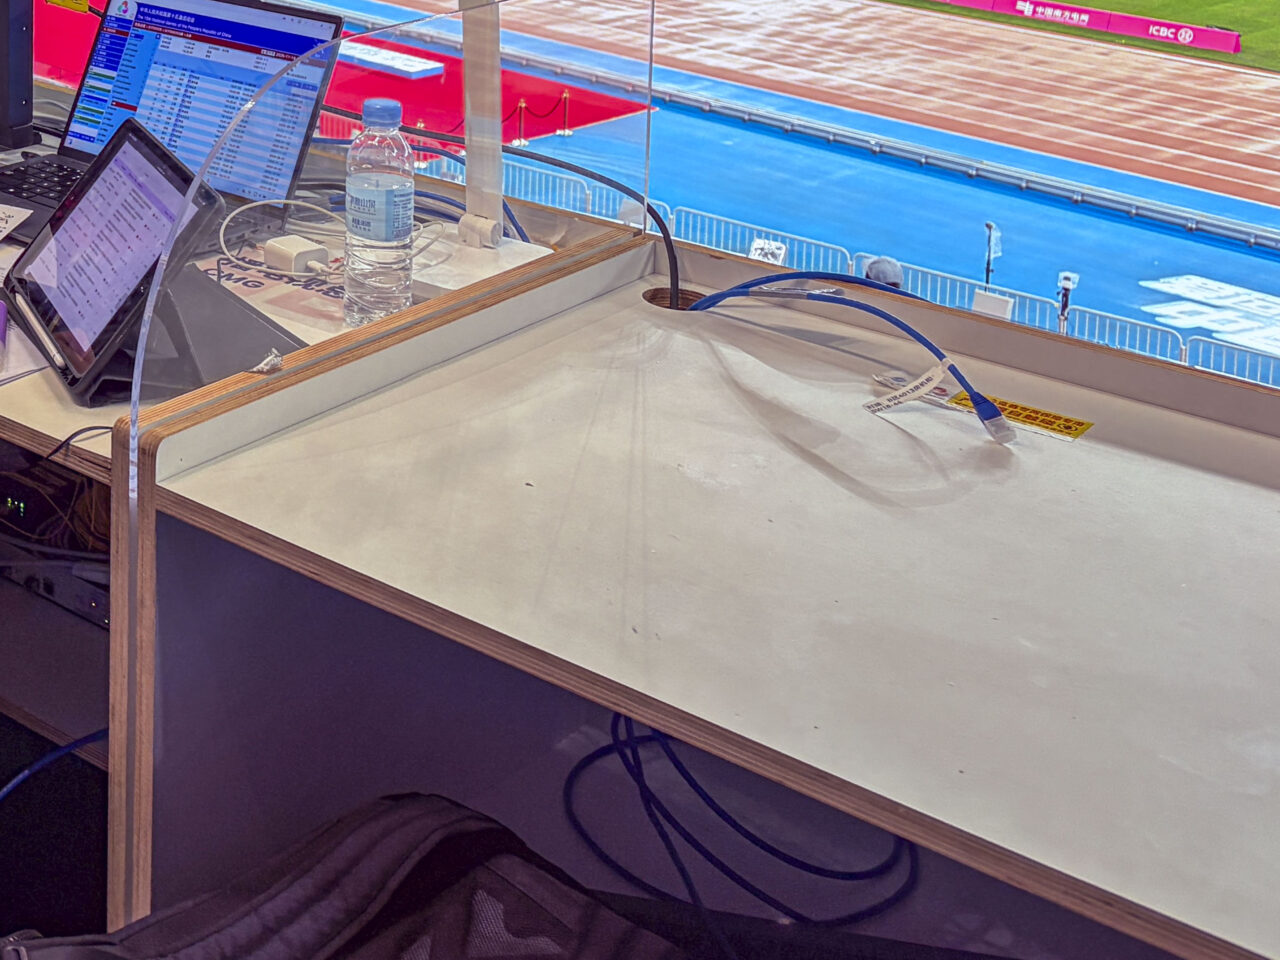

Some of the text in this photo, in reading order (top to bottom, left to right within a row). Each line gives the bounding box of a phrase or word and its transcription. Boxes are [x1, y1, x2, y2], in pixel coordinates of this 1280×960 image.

[1035, 6, 1089, 24] 中国南方电网
[1149, 25, 1175, 38] ICBC
[203, 268, 265, 289] CMG
